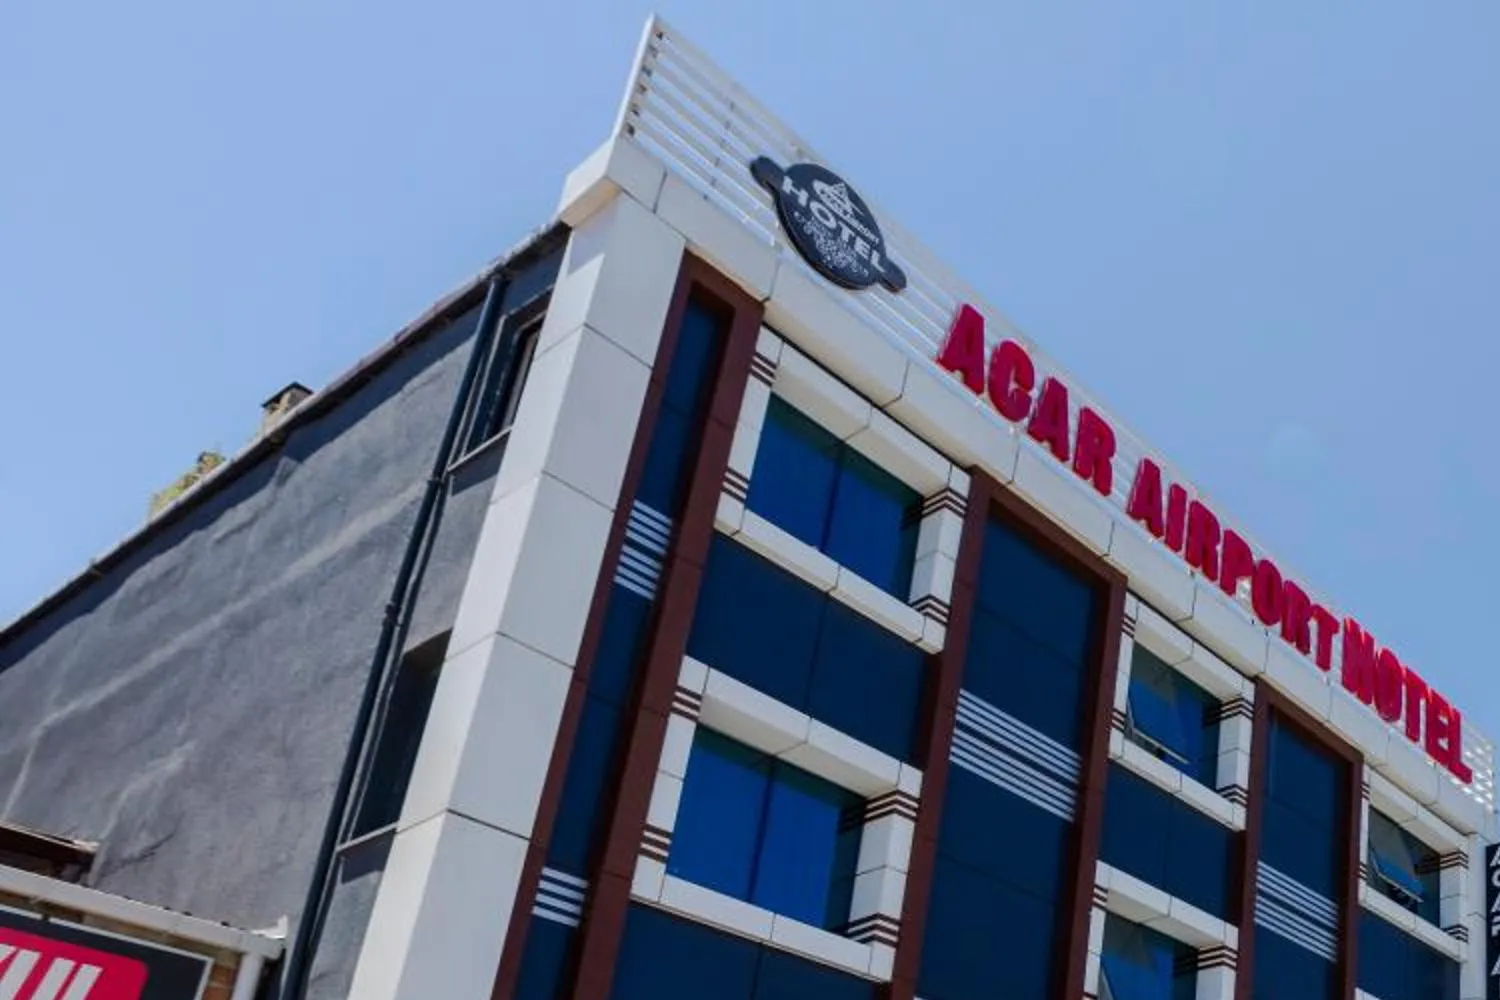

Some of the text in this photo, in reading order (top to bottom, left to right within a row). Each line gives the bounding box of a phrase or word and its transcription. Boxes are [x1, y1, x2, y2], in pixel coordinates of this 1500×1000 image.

[783, 175, 886, 273] HOTEL
[937, 303, 1474, 785] ACAR AIRPORT HOTEL
